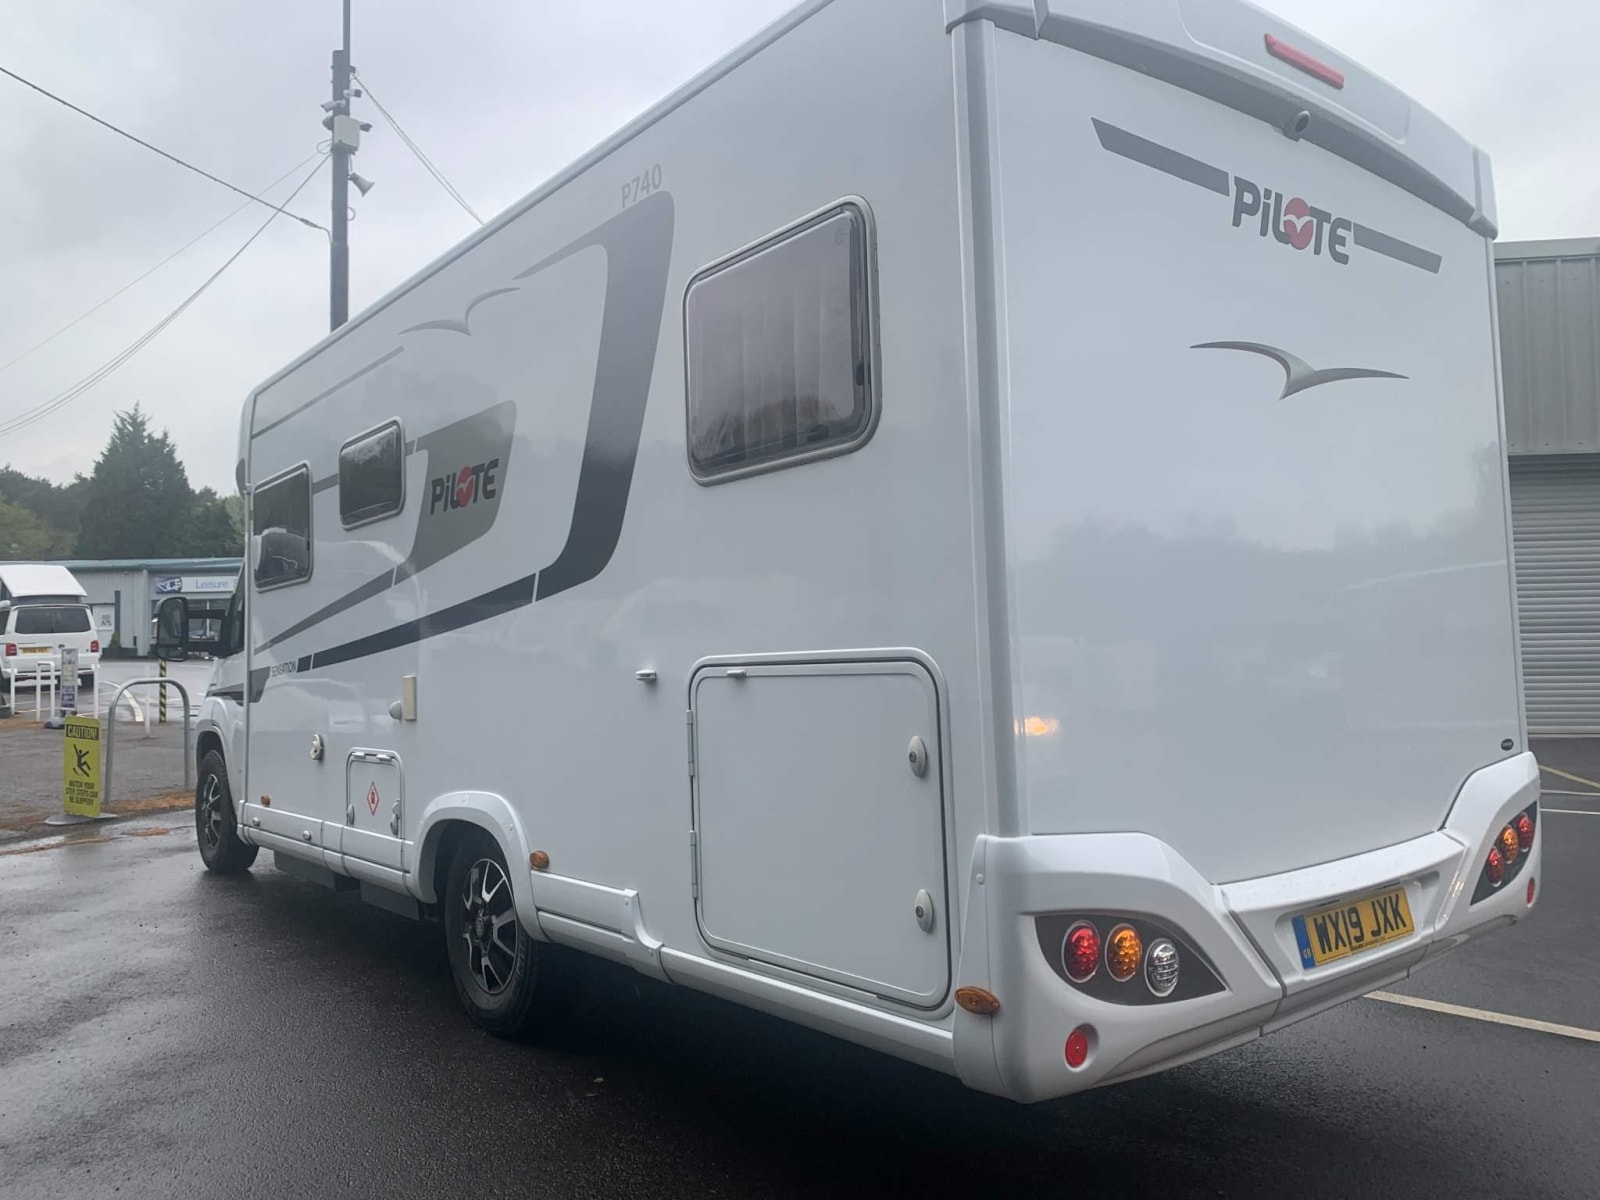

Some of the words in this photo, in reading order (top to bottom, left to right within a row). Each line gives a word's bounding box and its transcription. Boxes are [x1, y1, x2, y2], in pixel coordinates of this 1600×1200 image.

[622, 163, 661, 209] P740
[195, 580, 229, 589] Leisure
[271, 660, 297, 677] SENSATION
[67, 725, 98, 740] CAUTION!
[1313, 906, 1365, 955] WX19
[1370, 893, 1407, 938] JXK
[1303, 947, 1312, 960] GB
